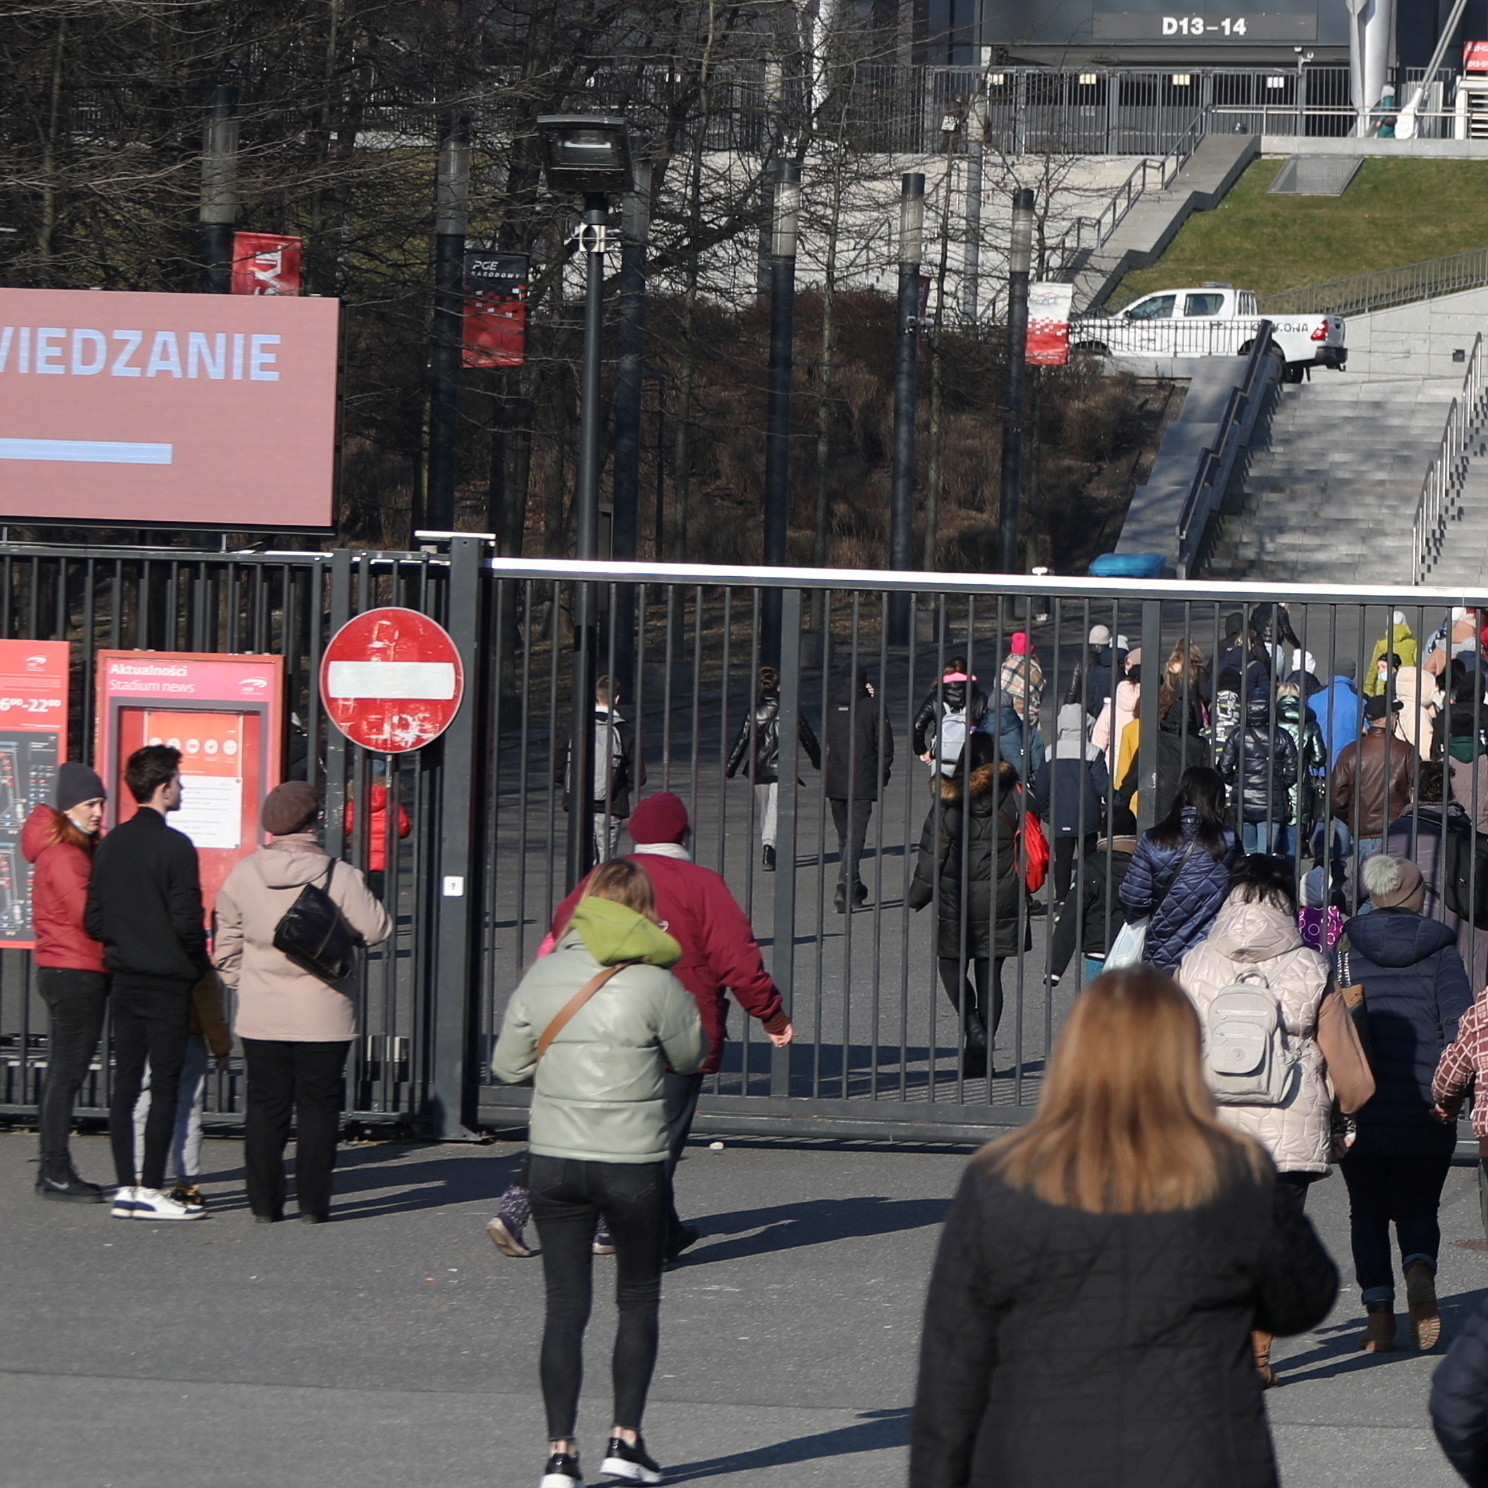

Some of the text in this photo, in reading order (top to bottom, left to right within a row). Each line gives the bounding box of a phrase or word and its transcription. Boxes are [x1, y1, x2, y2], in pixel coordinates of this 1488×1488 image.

[472, 260, 499, 271] PGE
[470, 271, 520, 279] NARODOWY
[0, 325, 281, 381] IEDZANIE
[110, 664, 188, 677] Aktualności
[109, 679, 195, 694] Stadium news
